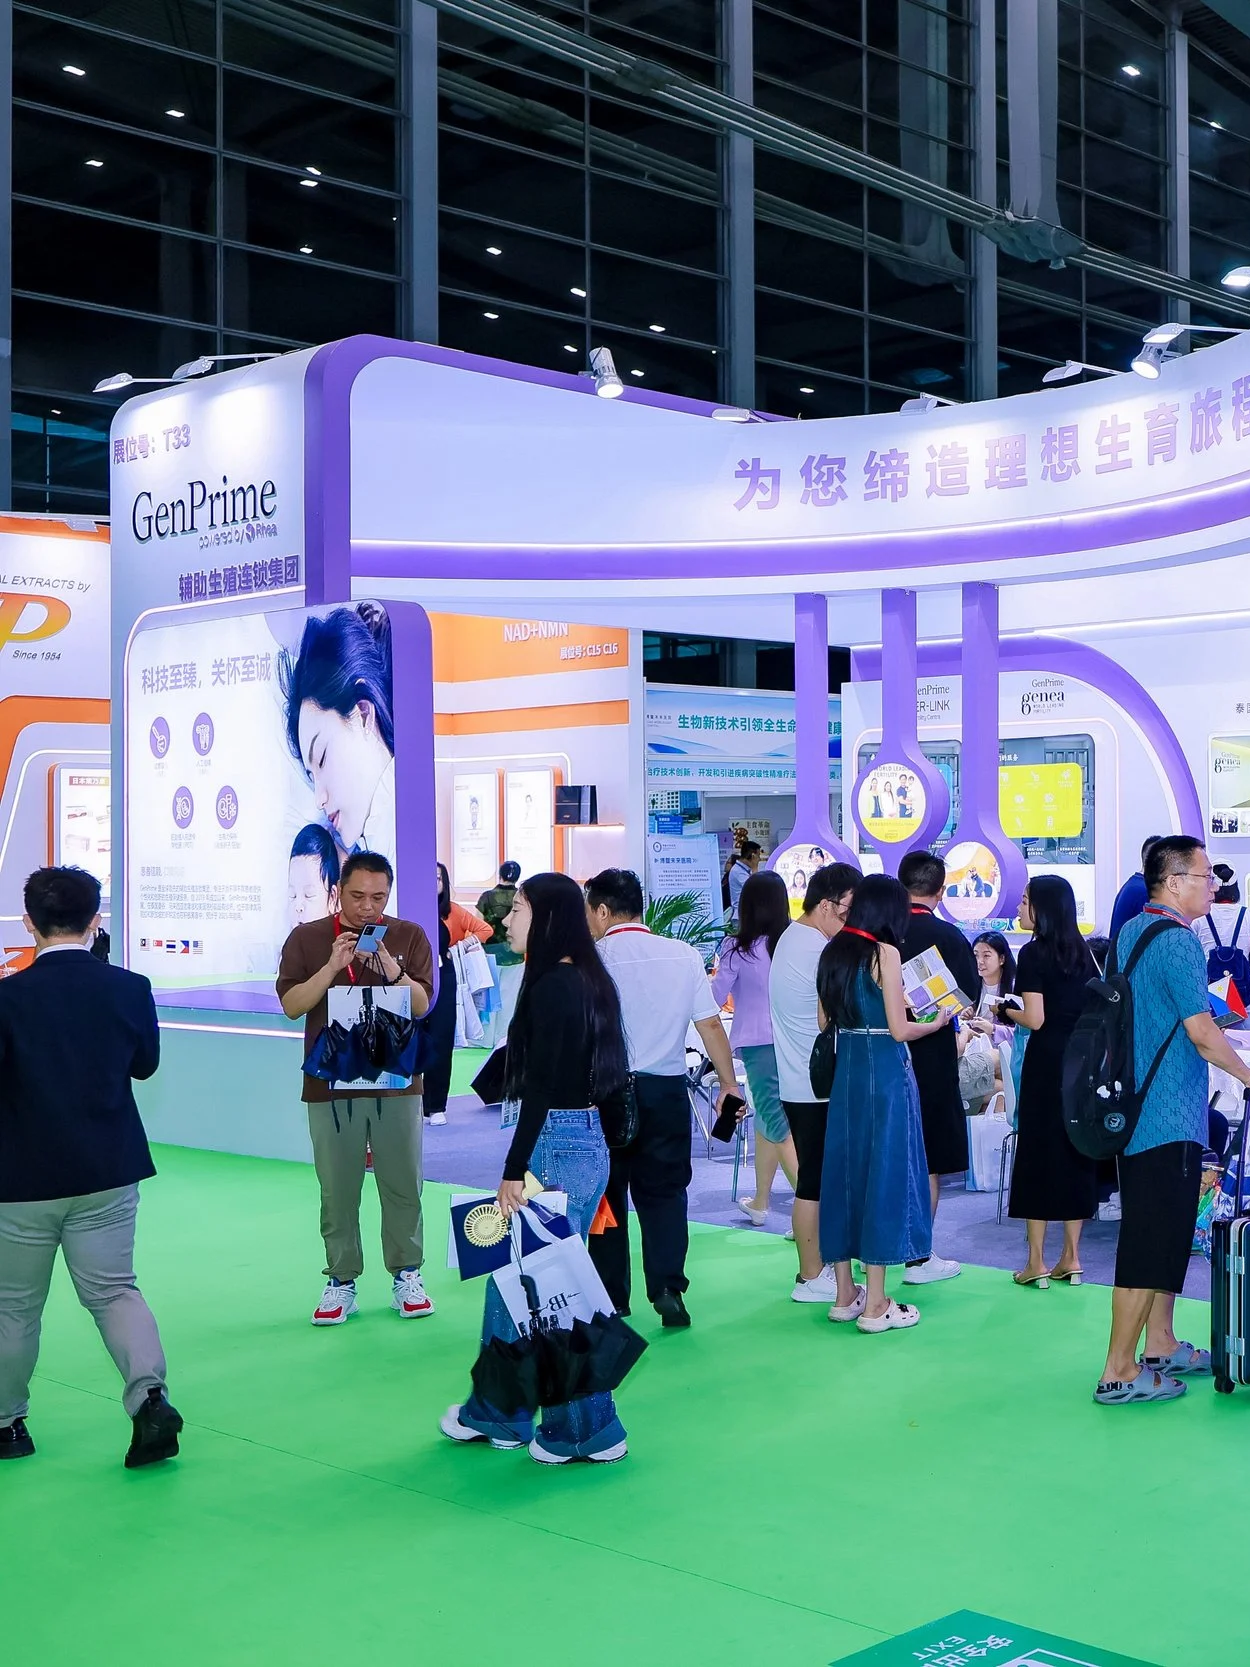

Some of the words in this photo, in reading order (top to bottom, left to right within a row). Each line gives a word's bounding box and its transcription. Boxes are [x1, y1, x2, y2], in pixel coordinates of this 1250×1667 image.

[132, 475, 278, 543] GenPrime
[256, 523, 278, 540] Rhea
[12, 575, 75, 590] EXTRACTS
[77, 581, 91, 593] by
[179, 555, 300, 600] 辅助生殖连锁集团
[12, 649, 37, 660] Since
[602, 642, 618, 654] C16
[141, 653, 271, 695] 科技至臻，关怀至诚
[1032, 678, 1065, 688] GenPrime
[1021, 691, 1065, 715] genea
[912, 1635, 967, 1661] EXIT
